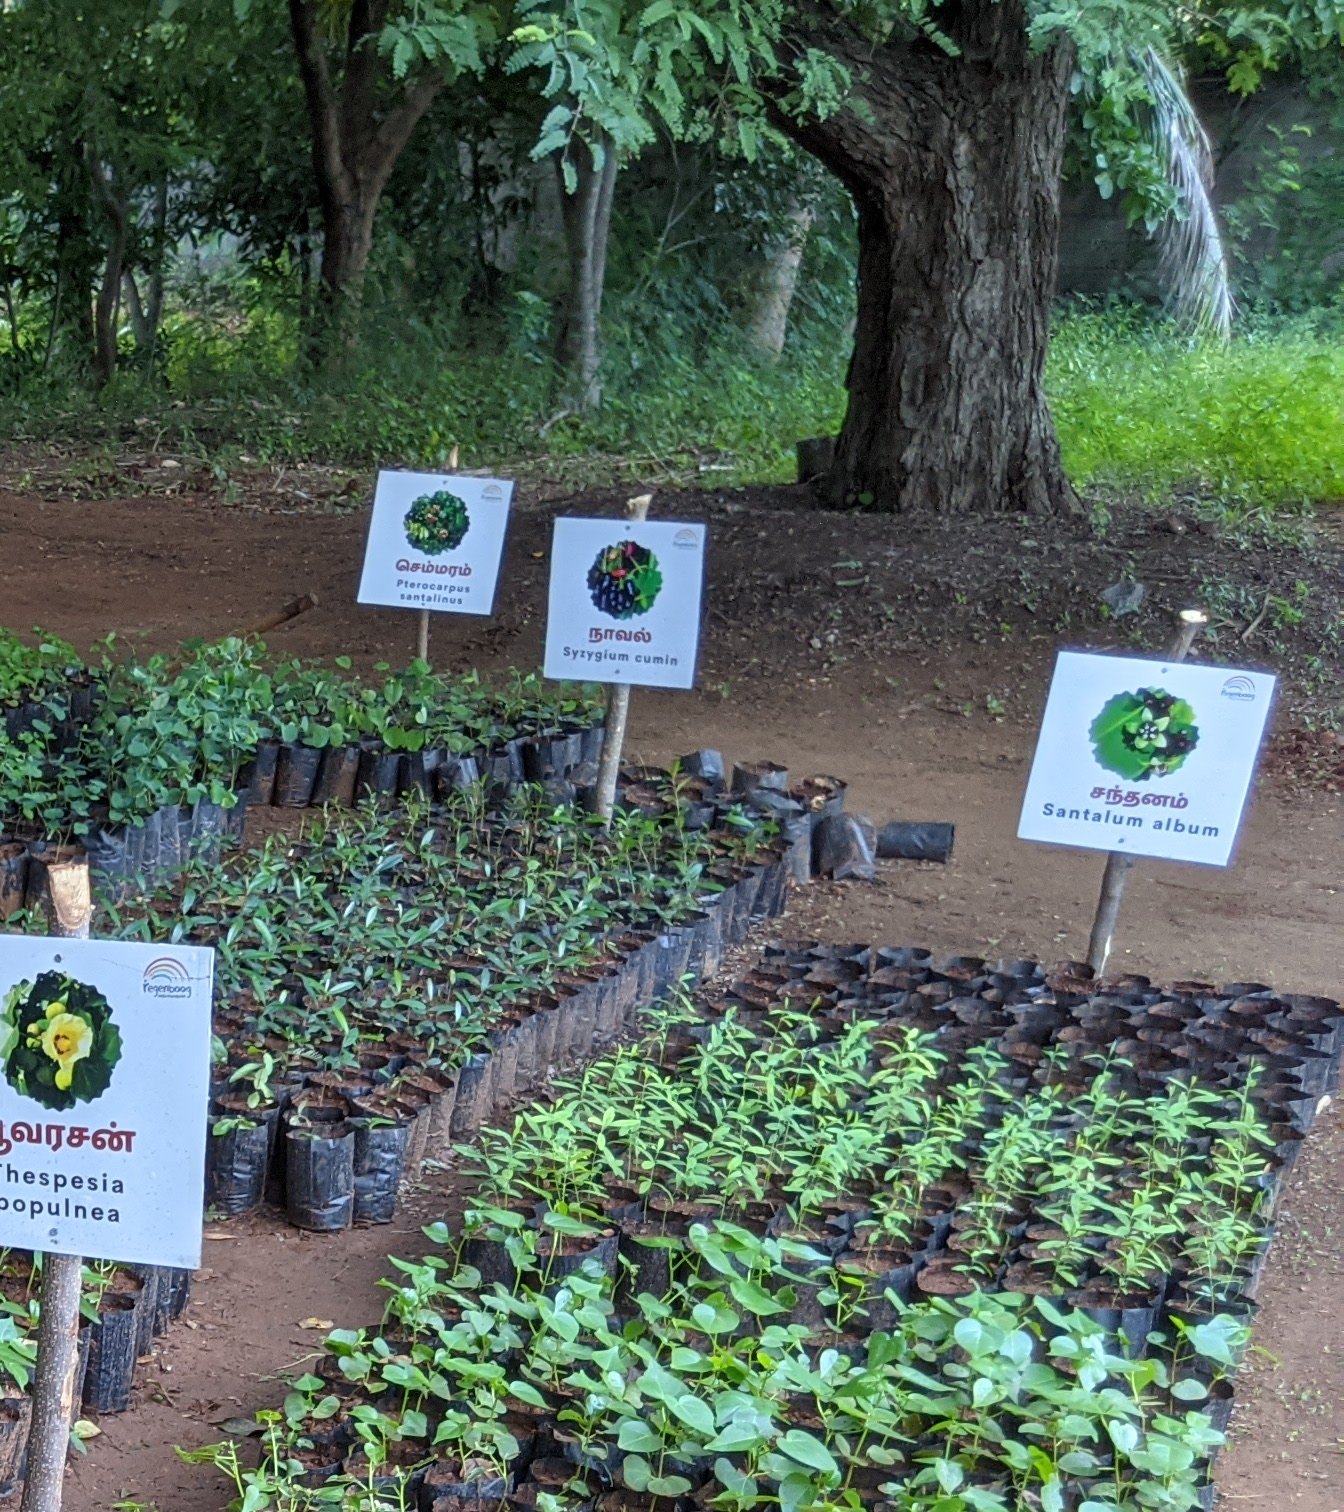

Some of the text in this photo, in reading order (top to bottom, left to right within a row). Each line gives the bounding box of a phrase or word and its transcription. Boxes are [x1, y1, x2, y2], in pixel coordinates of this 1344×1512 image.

[395, 558, 472, 578] செம்மரம்
[397, 579, 470, 594] Pterocarpus
[400, 593, 463, 605] santalinus
[588, 627, 652, 643] நாவல்
[563, 646, 678, 666] Syzygium cumin
[1090, 785, 1189, 809] சந்தனம்
[1042, 803, 1220, 837] Santalum album
